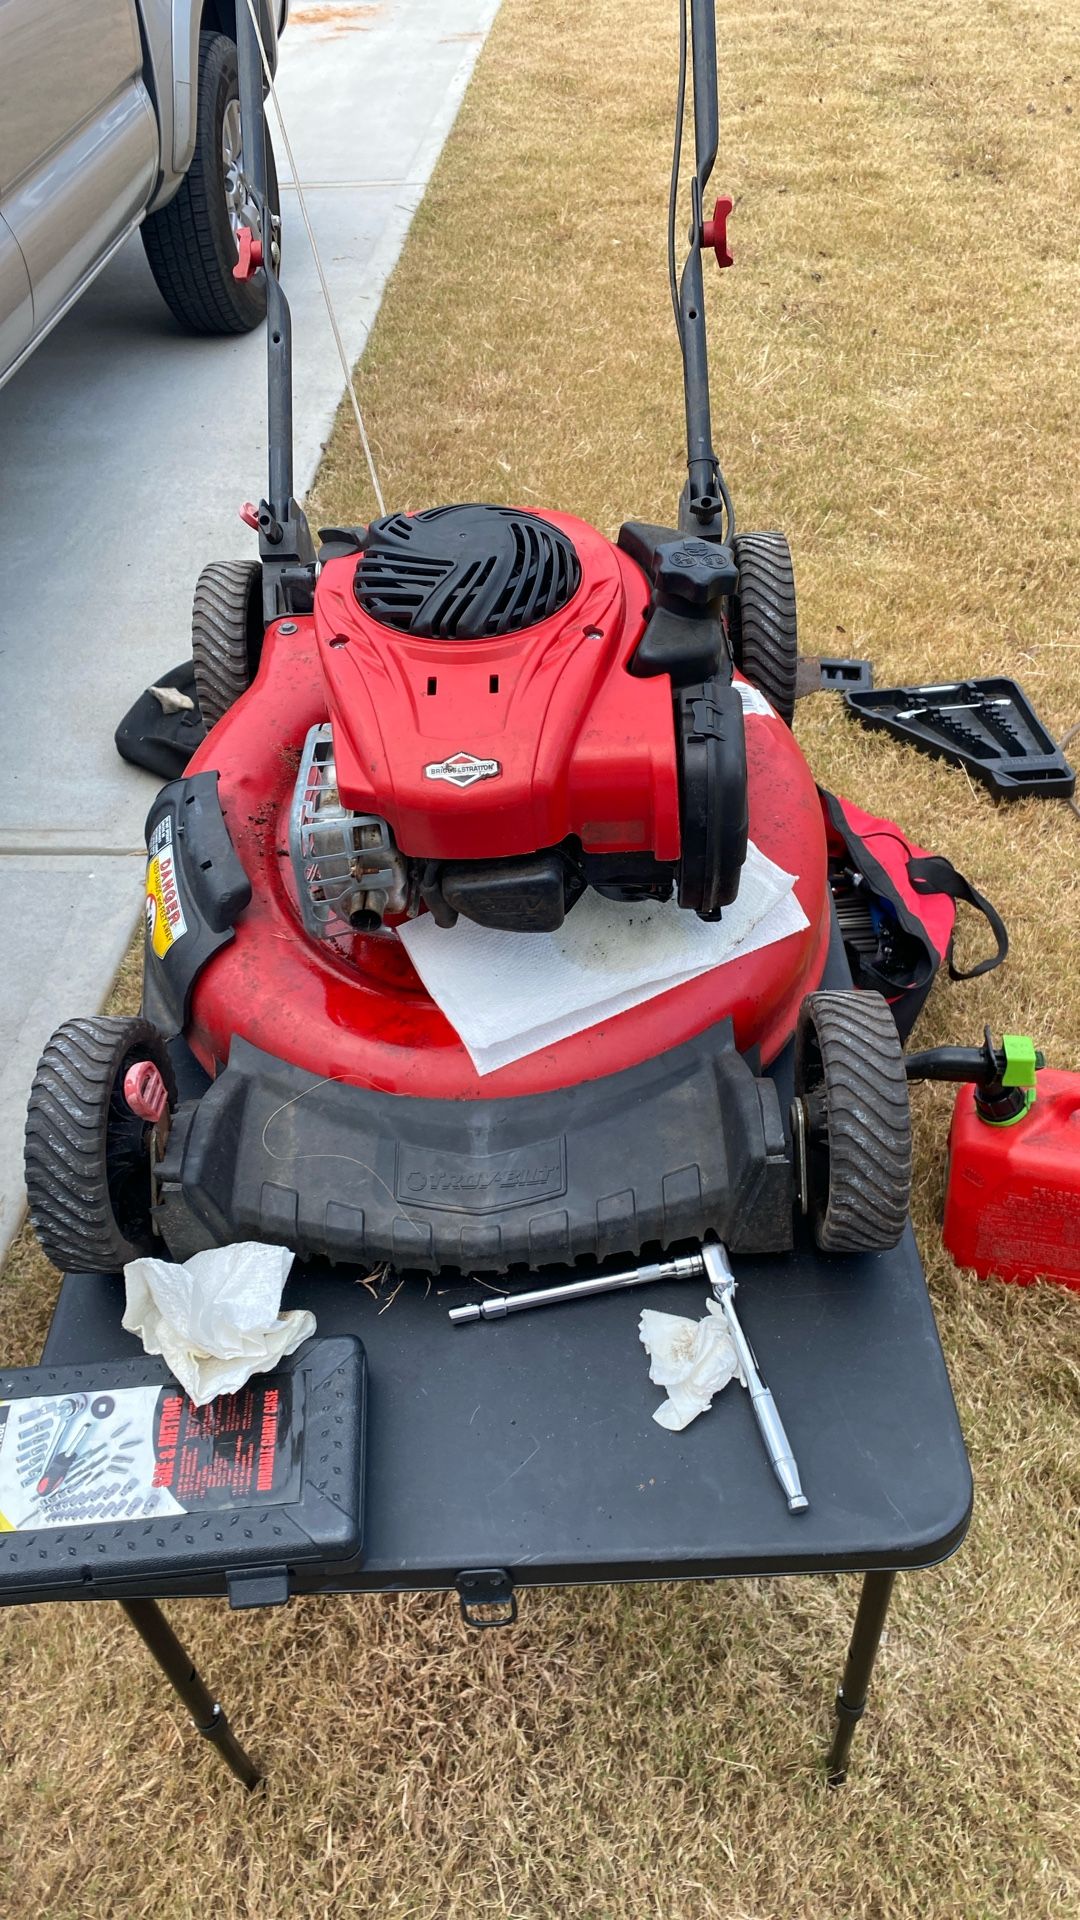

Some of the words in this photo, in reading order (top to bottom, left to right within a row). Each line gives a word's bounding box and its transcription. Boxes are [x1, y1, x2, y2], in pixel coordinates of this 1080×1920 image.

[430, 765, 457, 775] BRIGGS
[462, 763, 494, 773] STRATTON
[160, 857, 180, 927] DANGER
[263, 1389, 279, 1414] CASE
[158, 1396, 183, 1447] METRIC
[261, 1415, 277, 1446] CARRY
[159, 1448, 177, 1459] &
[151, 1461, 175, 1488] SAE
[256, 1446, 275, 1491] DURABLE
